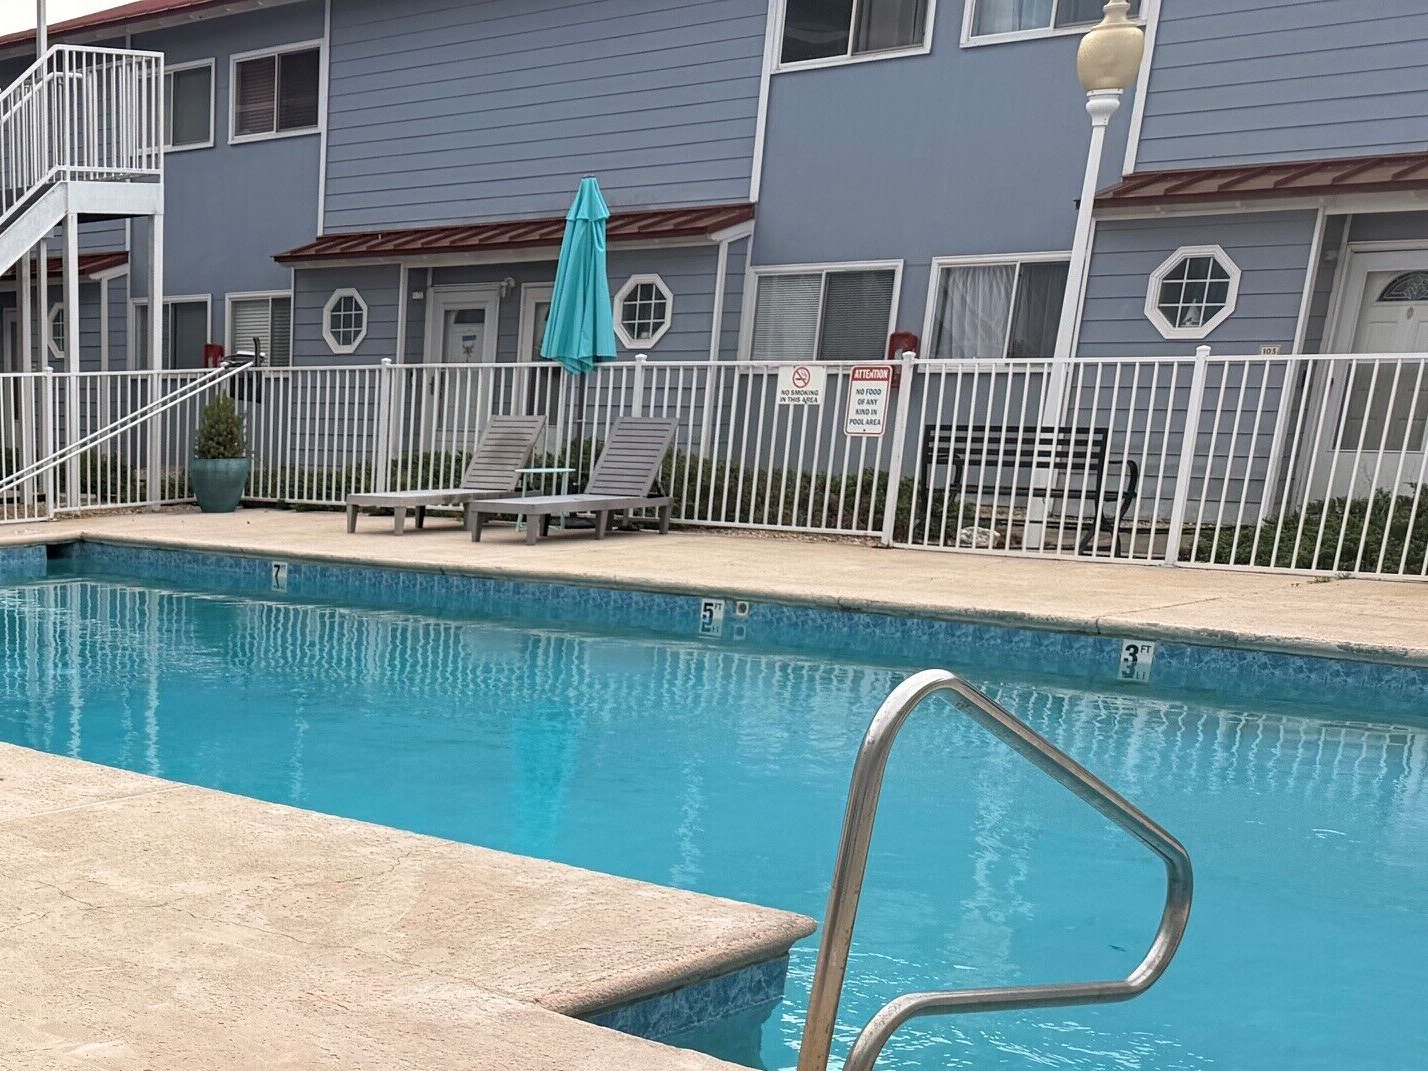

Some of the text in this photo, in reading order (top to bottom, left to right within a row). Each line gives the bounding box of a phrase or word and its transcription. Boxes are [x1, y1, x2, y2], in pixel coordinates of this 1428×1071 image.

[853, 369, 888, 379] ATTENTION
[865, 418, 881, 426] AREA
[274, 564, 280, 577] 7
[703, 602, 714, 618] 5
[1124, 644, 1152, 662] 3 FT
